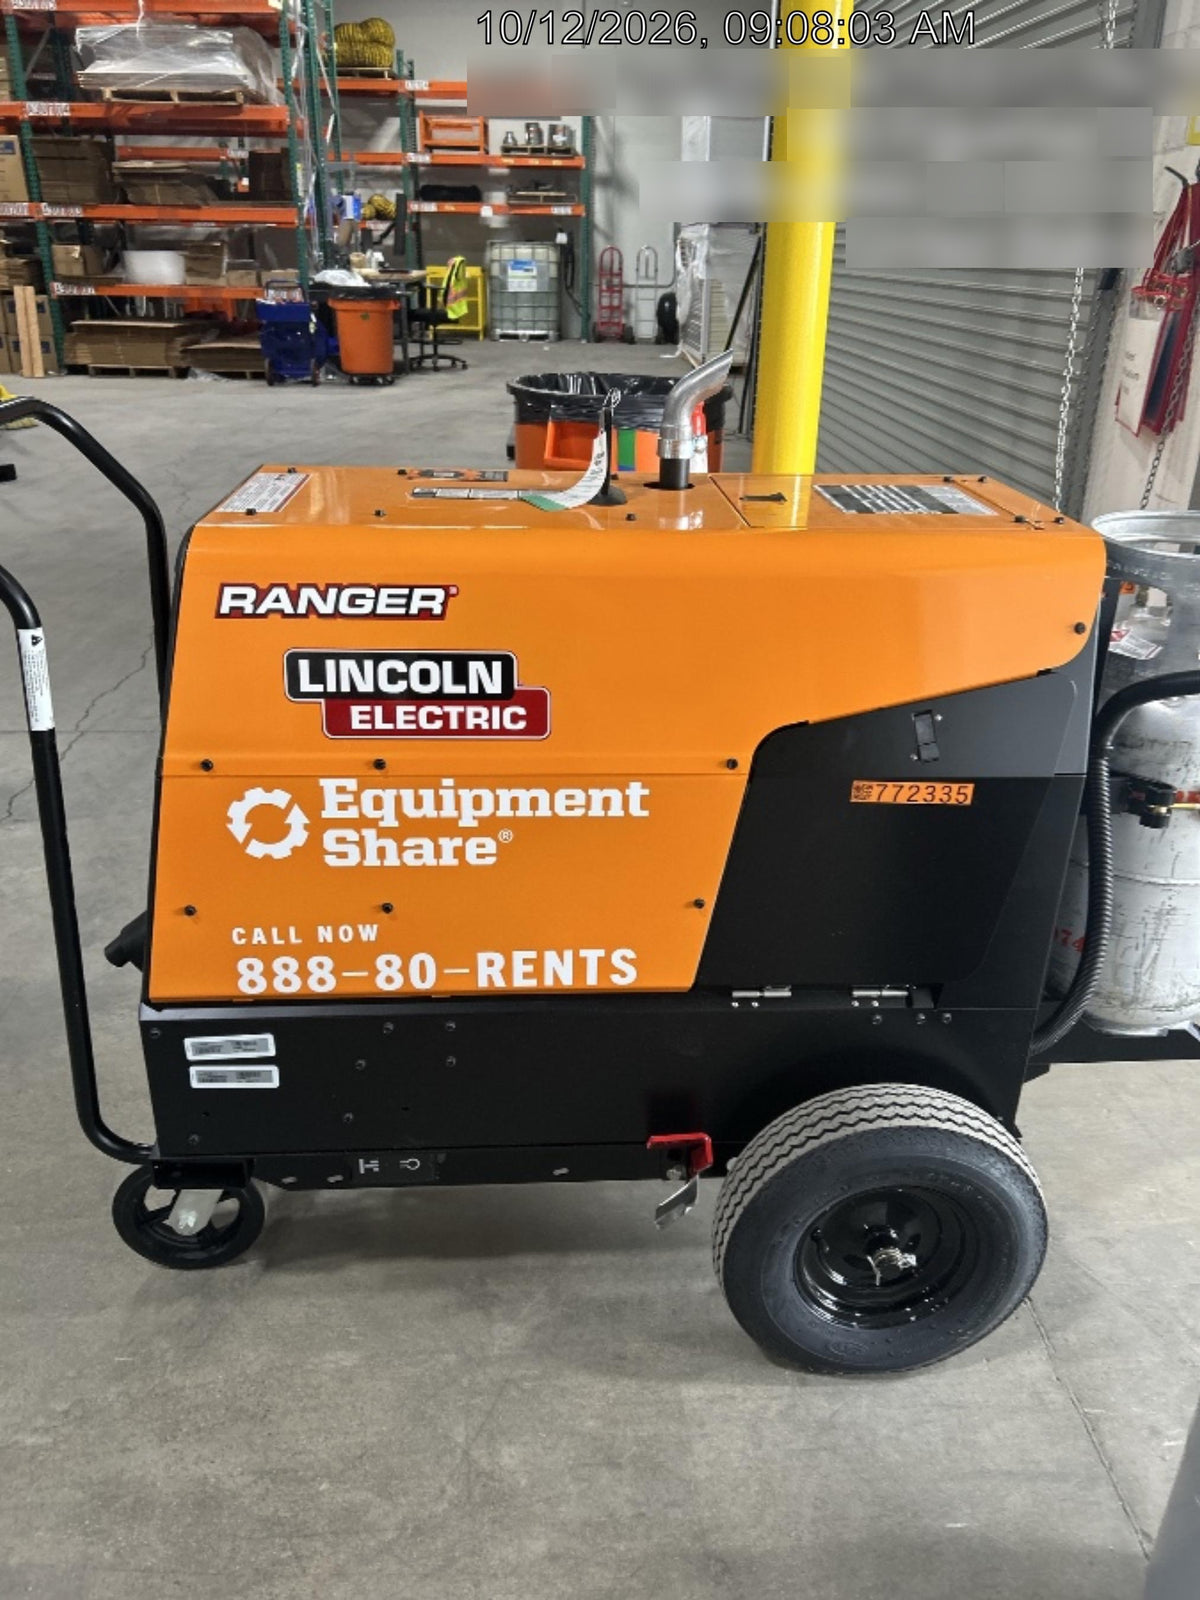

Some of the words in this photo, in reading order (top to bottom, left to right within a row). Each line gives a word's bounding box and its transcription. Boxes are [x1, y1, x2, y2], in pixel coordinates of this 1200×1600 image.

[298, 659, 503, 695] LINCOLN
[350, 704, 528, 731] ELECTRIC
[319, 778, 650, 828] Equipment
[875, 783, 970, 804] 772335
[231, 926, 303, 945] CALL
[317, 924, 379, 943] NOW
